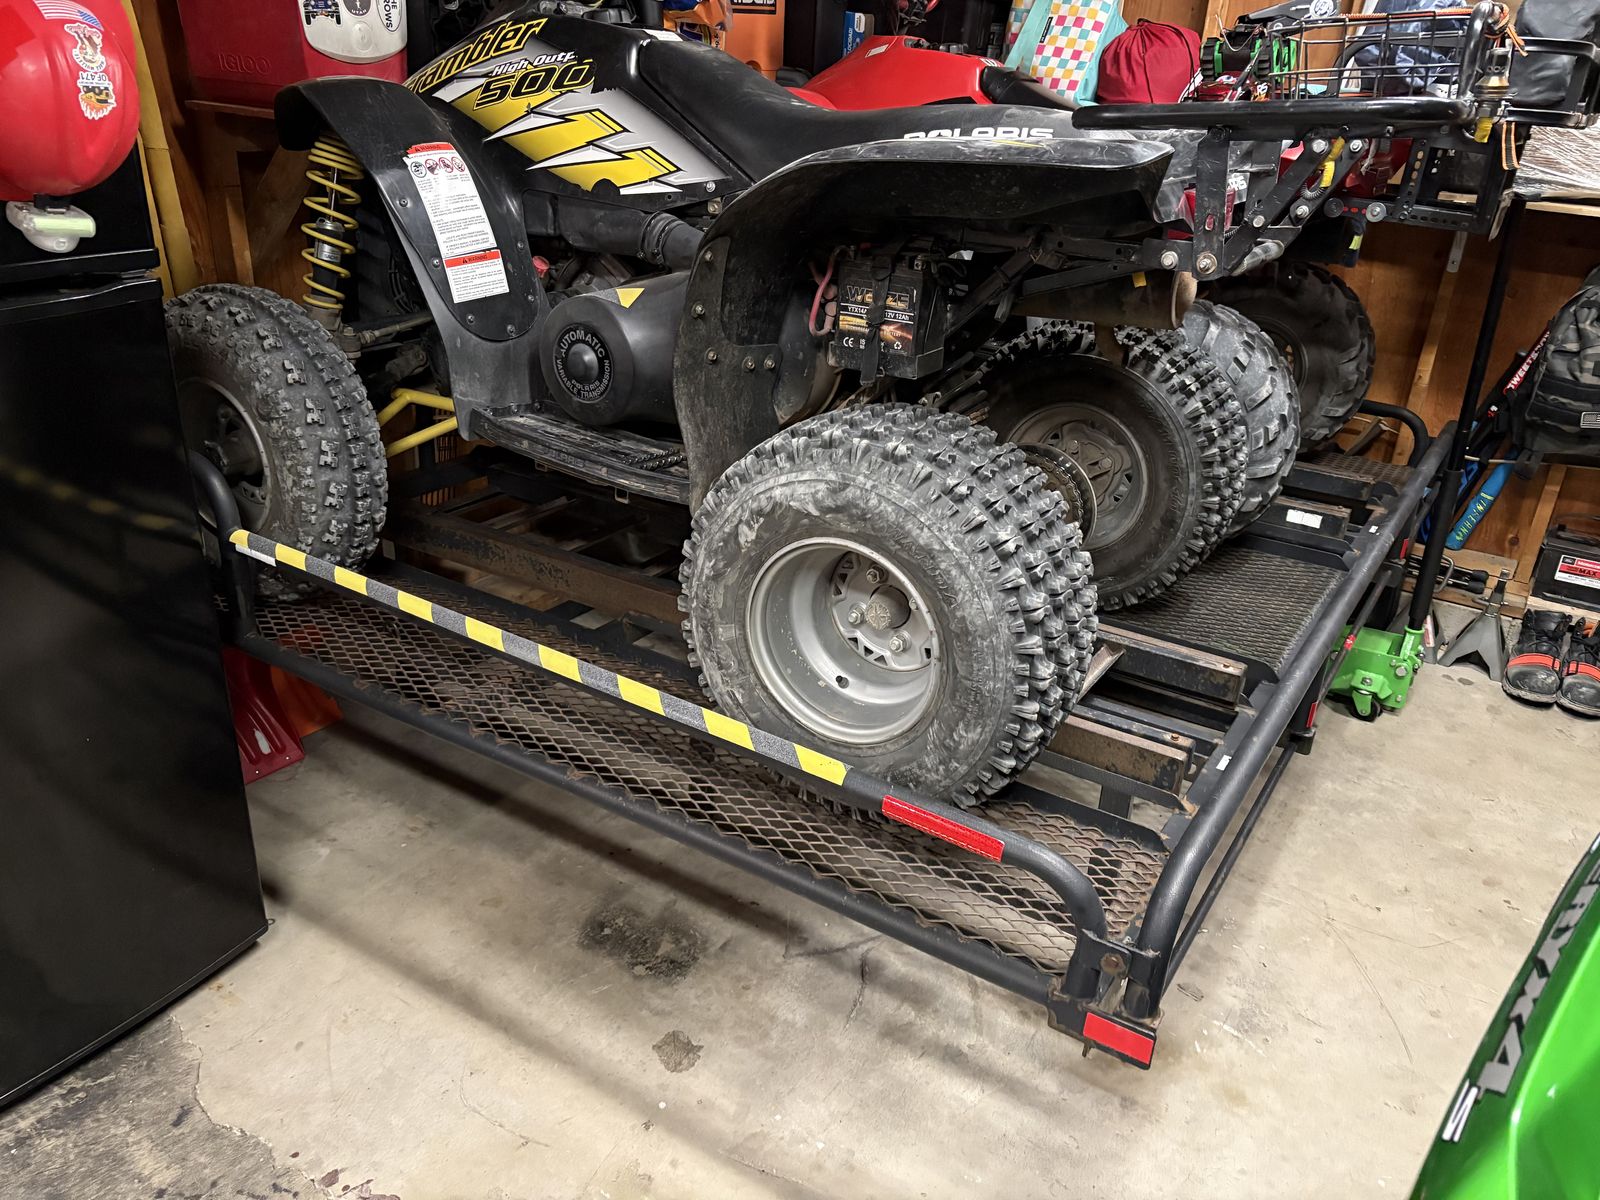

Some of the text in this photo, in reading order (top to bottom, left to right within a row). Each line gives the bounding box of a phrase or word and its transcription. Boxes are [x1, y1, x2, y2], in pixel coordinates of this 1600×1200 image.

[217, 54, 272, 75] IGLOO
[491, 61, 528, 77] High
[473, 59, 596, 110] 500
[468, 254, 488, 263] WARNING
[846, 285, 910, 310] WEZE
[560, 329, 606, 358] AUTOMATIC
[556, 358, 611, 399] VARIABLE TRANSMISSION
[571, 379, 600, 392] POLARIS
